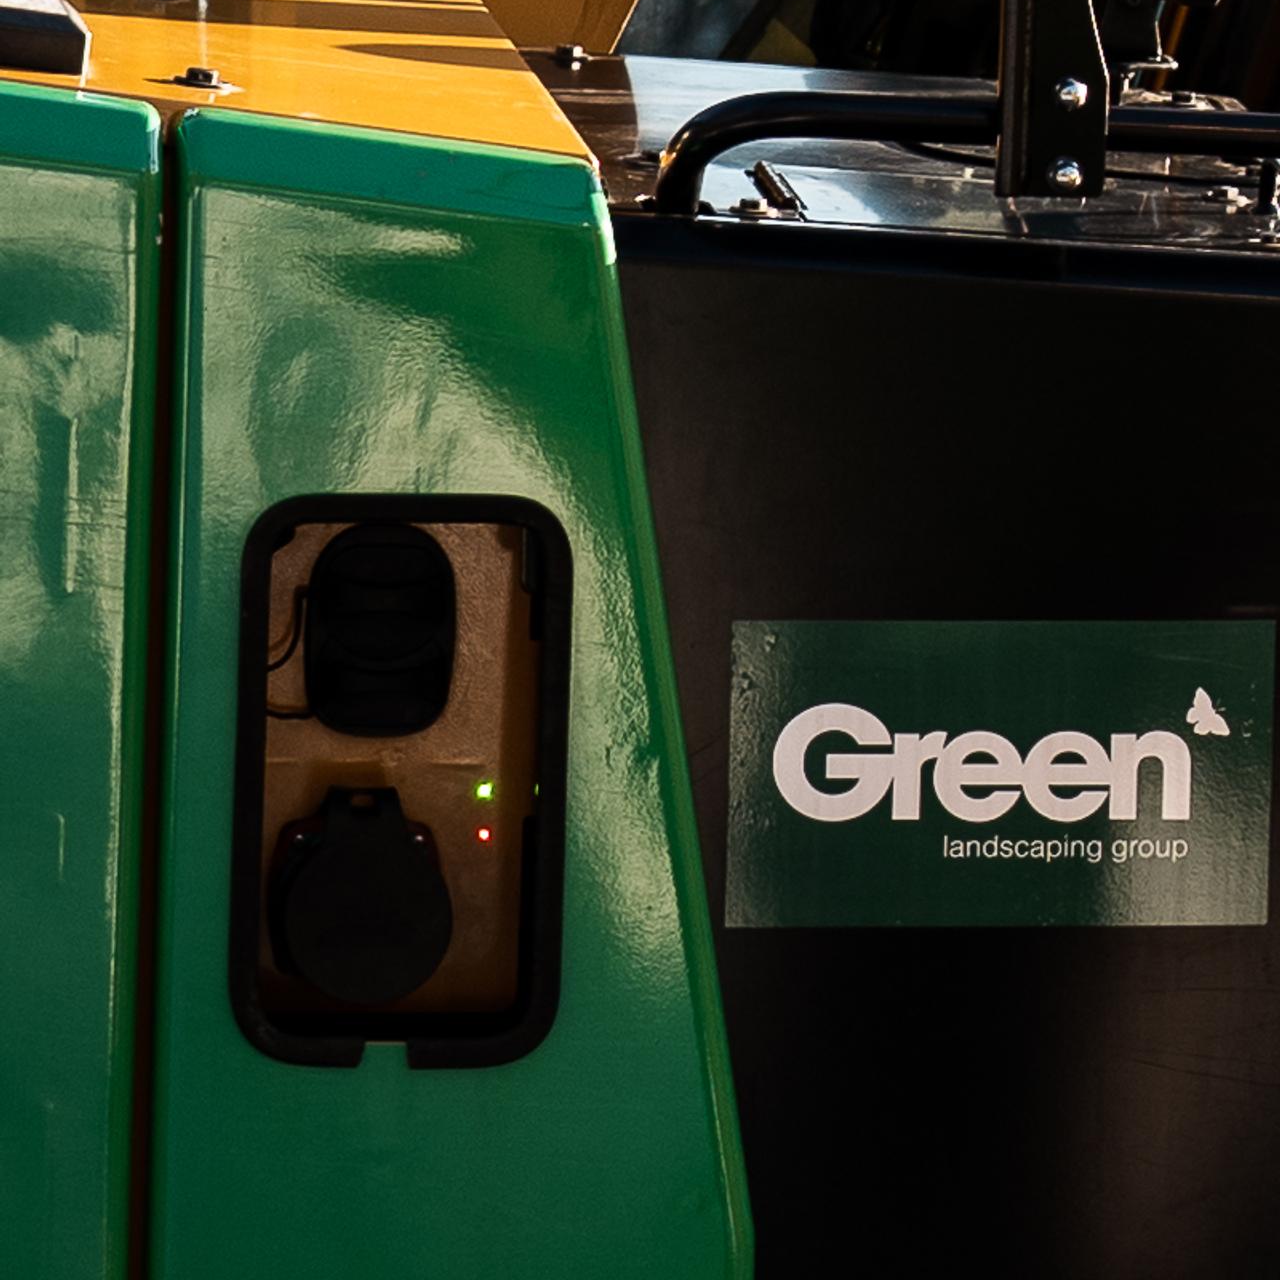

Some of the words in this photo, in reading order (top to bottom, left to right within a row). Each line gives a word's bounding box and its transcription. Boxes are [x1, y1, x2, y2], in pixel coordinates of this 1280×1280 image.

[773, 702, 1192, 822] Green
[942, 834, 1103, 863] landscaping
[1111, 839, 1190, 864] group
